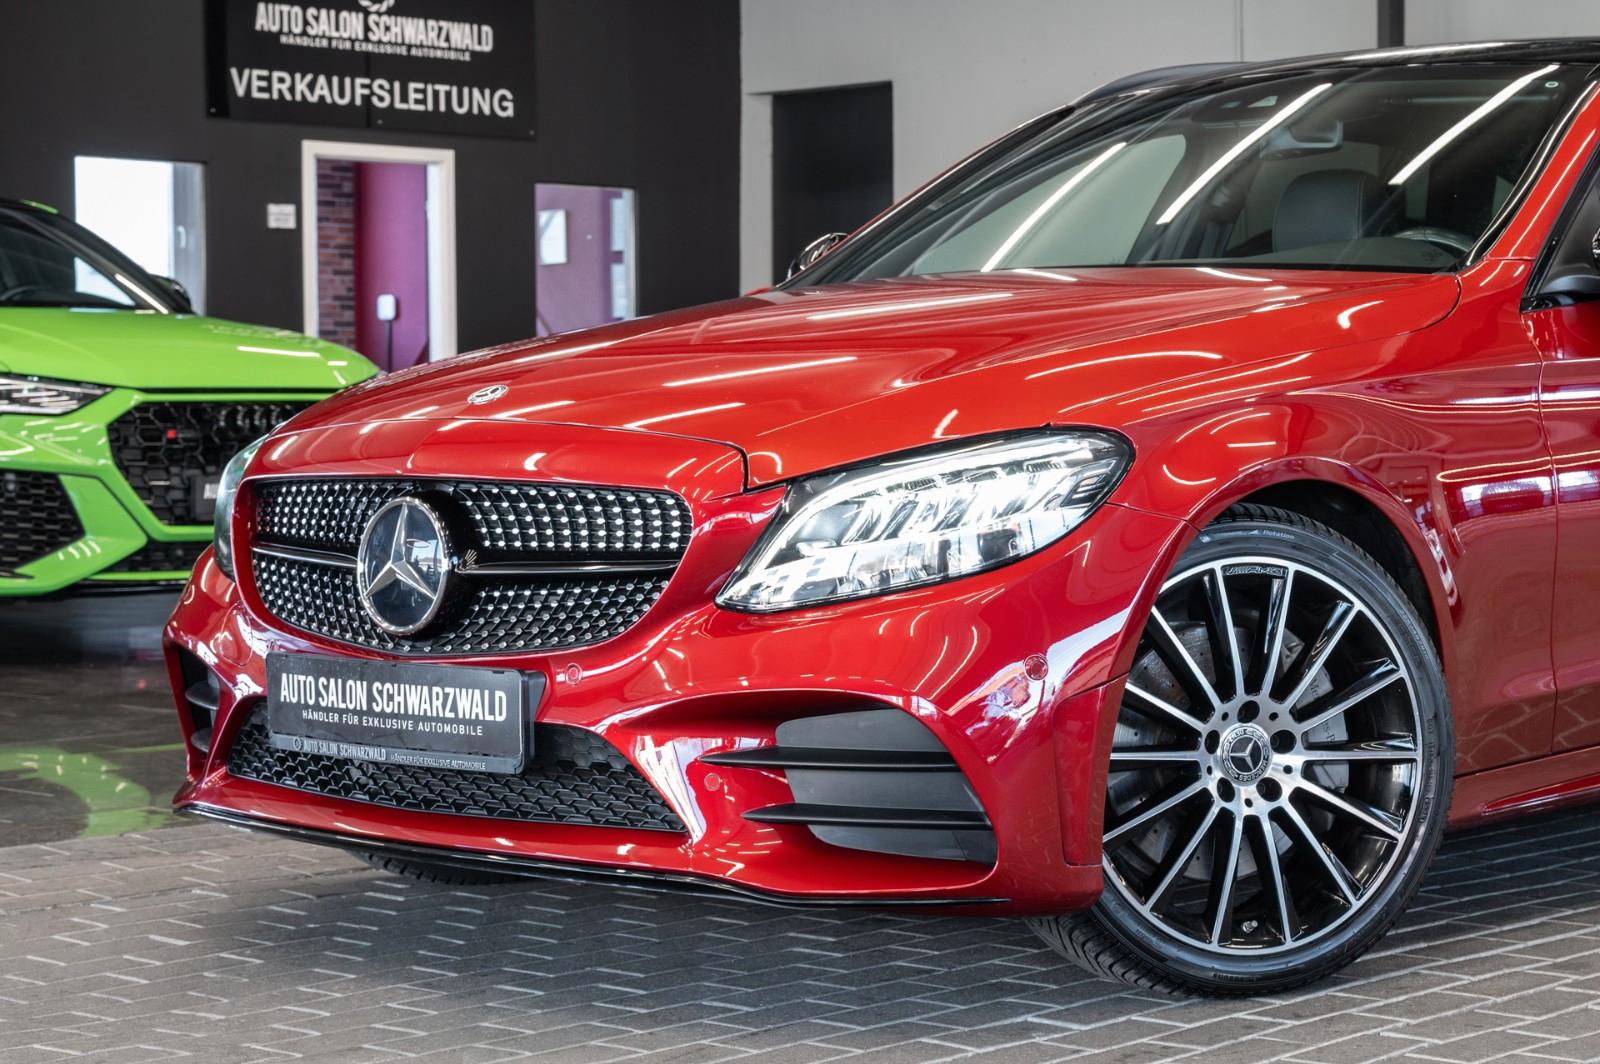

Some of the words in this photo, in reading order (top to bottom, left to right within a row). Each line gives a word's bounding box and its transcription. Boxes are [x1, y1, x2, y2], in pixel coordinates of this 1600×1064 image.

[254, 2, 301, 34] AUTO
[306, 8, 364, 41] SALON
[367, 13, 493, 53] SCHWARZWALD
[410, 45, 471, 62] AUTOMOBILE
[229, 67, 514, 118] VERKAUFSLEITUNG
[280, 673, 316, 705] AUTO
[318, 677, 367, 711] SALON
[372, 681, 507, 722] SCHWARZWALD
[302, 708, 340, 724] HÄNDLER
[342, 712, 359, 725] FÜR
[362, 716, 414, 731] EXKLUSIVE
[417, 721, 483, 736] AUTOMOBILE
[303, 740, 318, 753] AUTO
[319, 741, 338, 756] SALON
[339, 743, 386, 761] SCHWARZWALD
